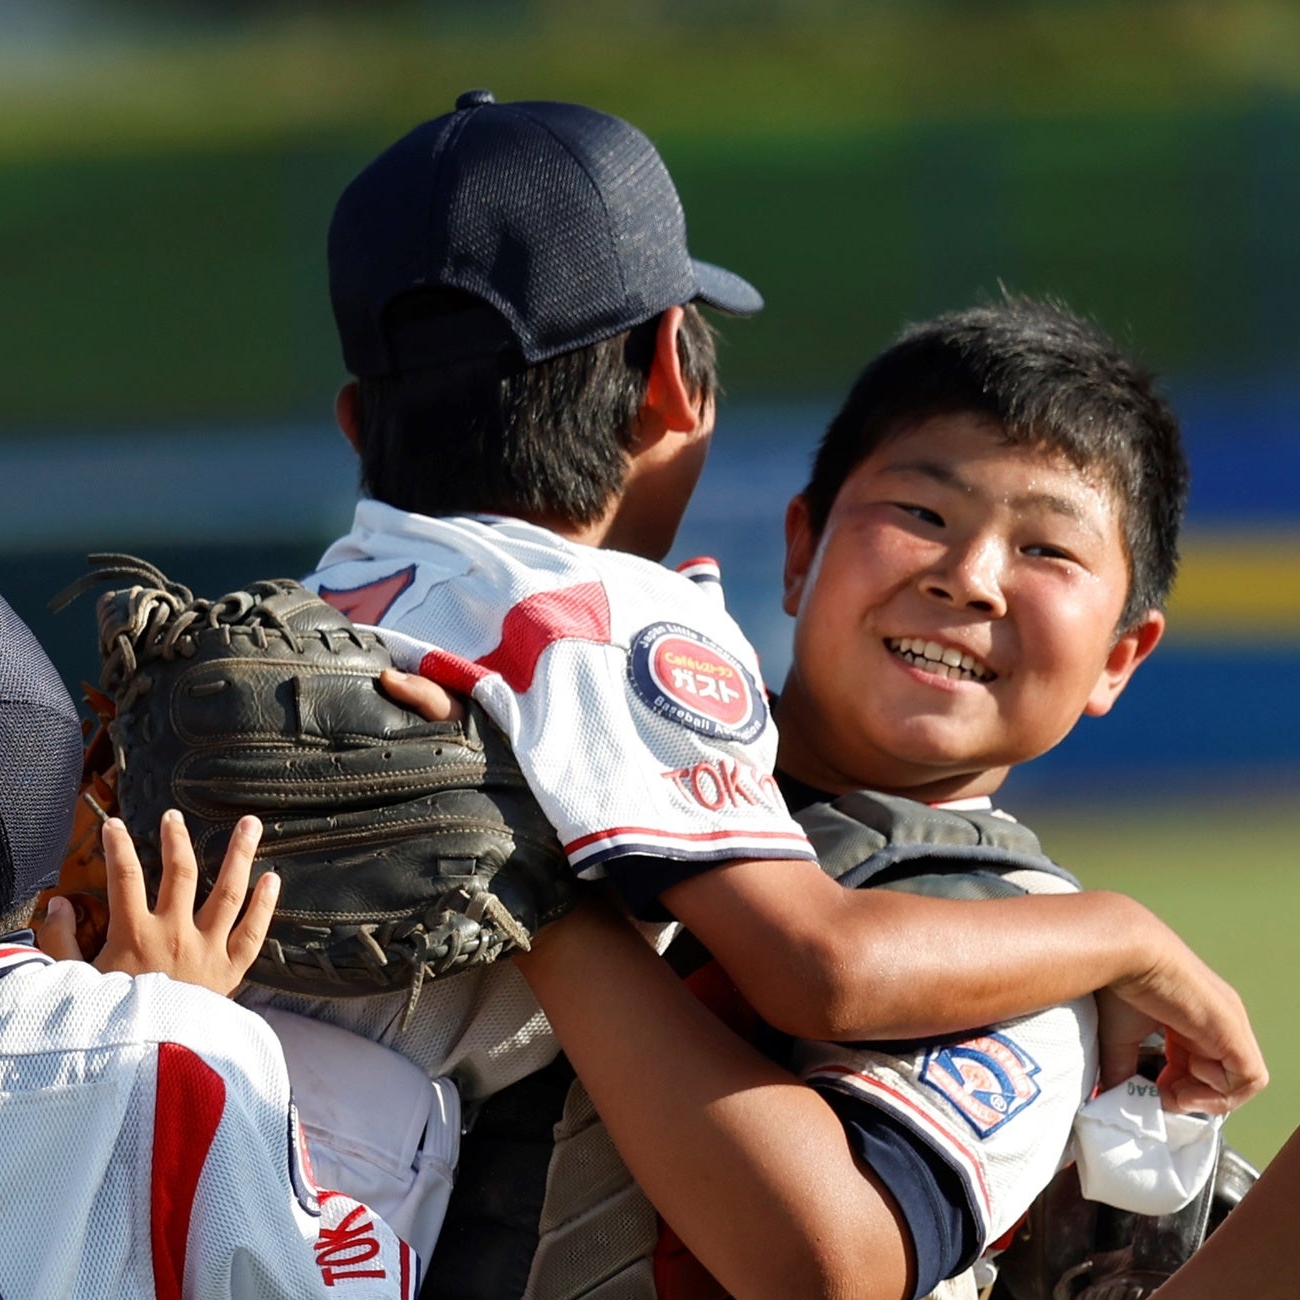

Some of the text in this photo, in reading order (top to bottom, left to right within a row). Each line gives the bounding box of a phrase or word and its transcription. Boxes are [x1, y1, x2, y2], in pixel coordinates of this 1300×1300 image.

[671, 667, 740, 704] ガスト
[654, 695, 711, 730] Baseball
